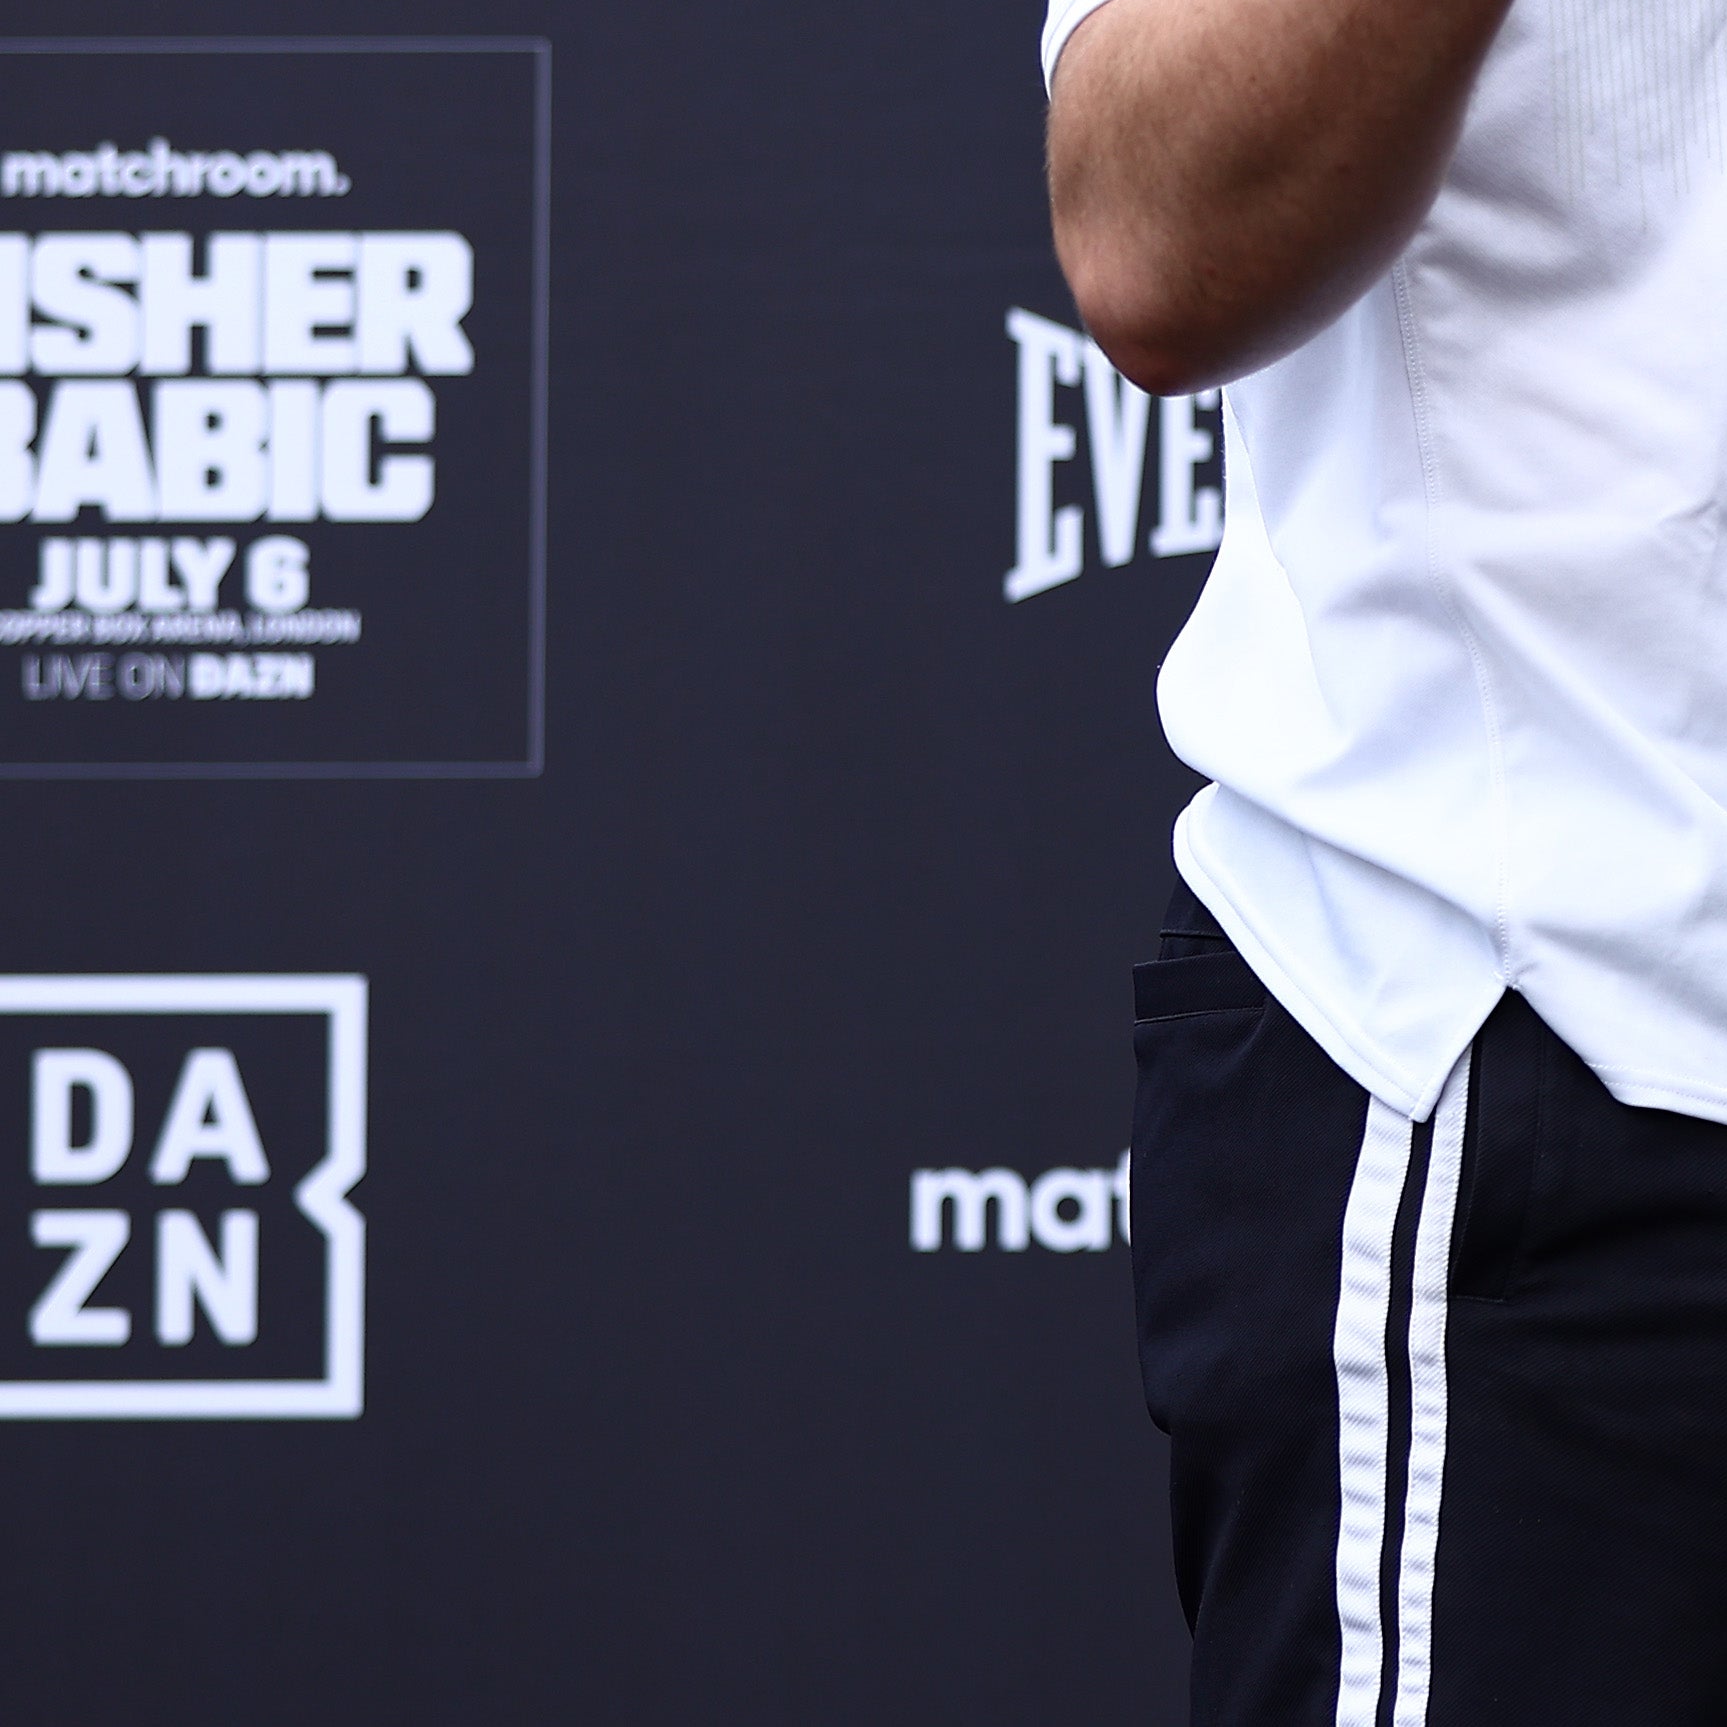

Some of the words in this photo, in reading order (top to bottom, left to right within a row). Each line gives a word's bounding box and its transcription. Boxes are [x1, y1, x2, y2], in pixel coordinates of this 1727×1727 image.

[29, 536, 236, 612] JULY
[245, 534, 311, 614] 6
[21, 651, 115, 701] LIVE
[116, 651, 186, 701] ON
[187, 651, 315, 700] DAZN
[32, 1047, 270, 1185] DA
[29, 1208, 260, 1346] ZN
